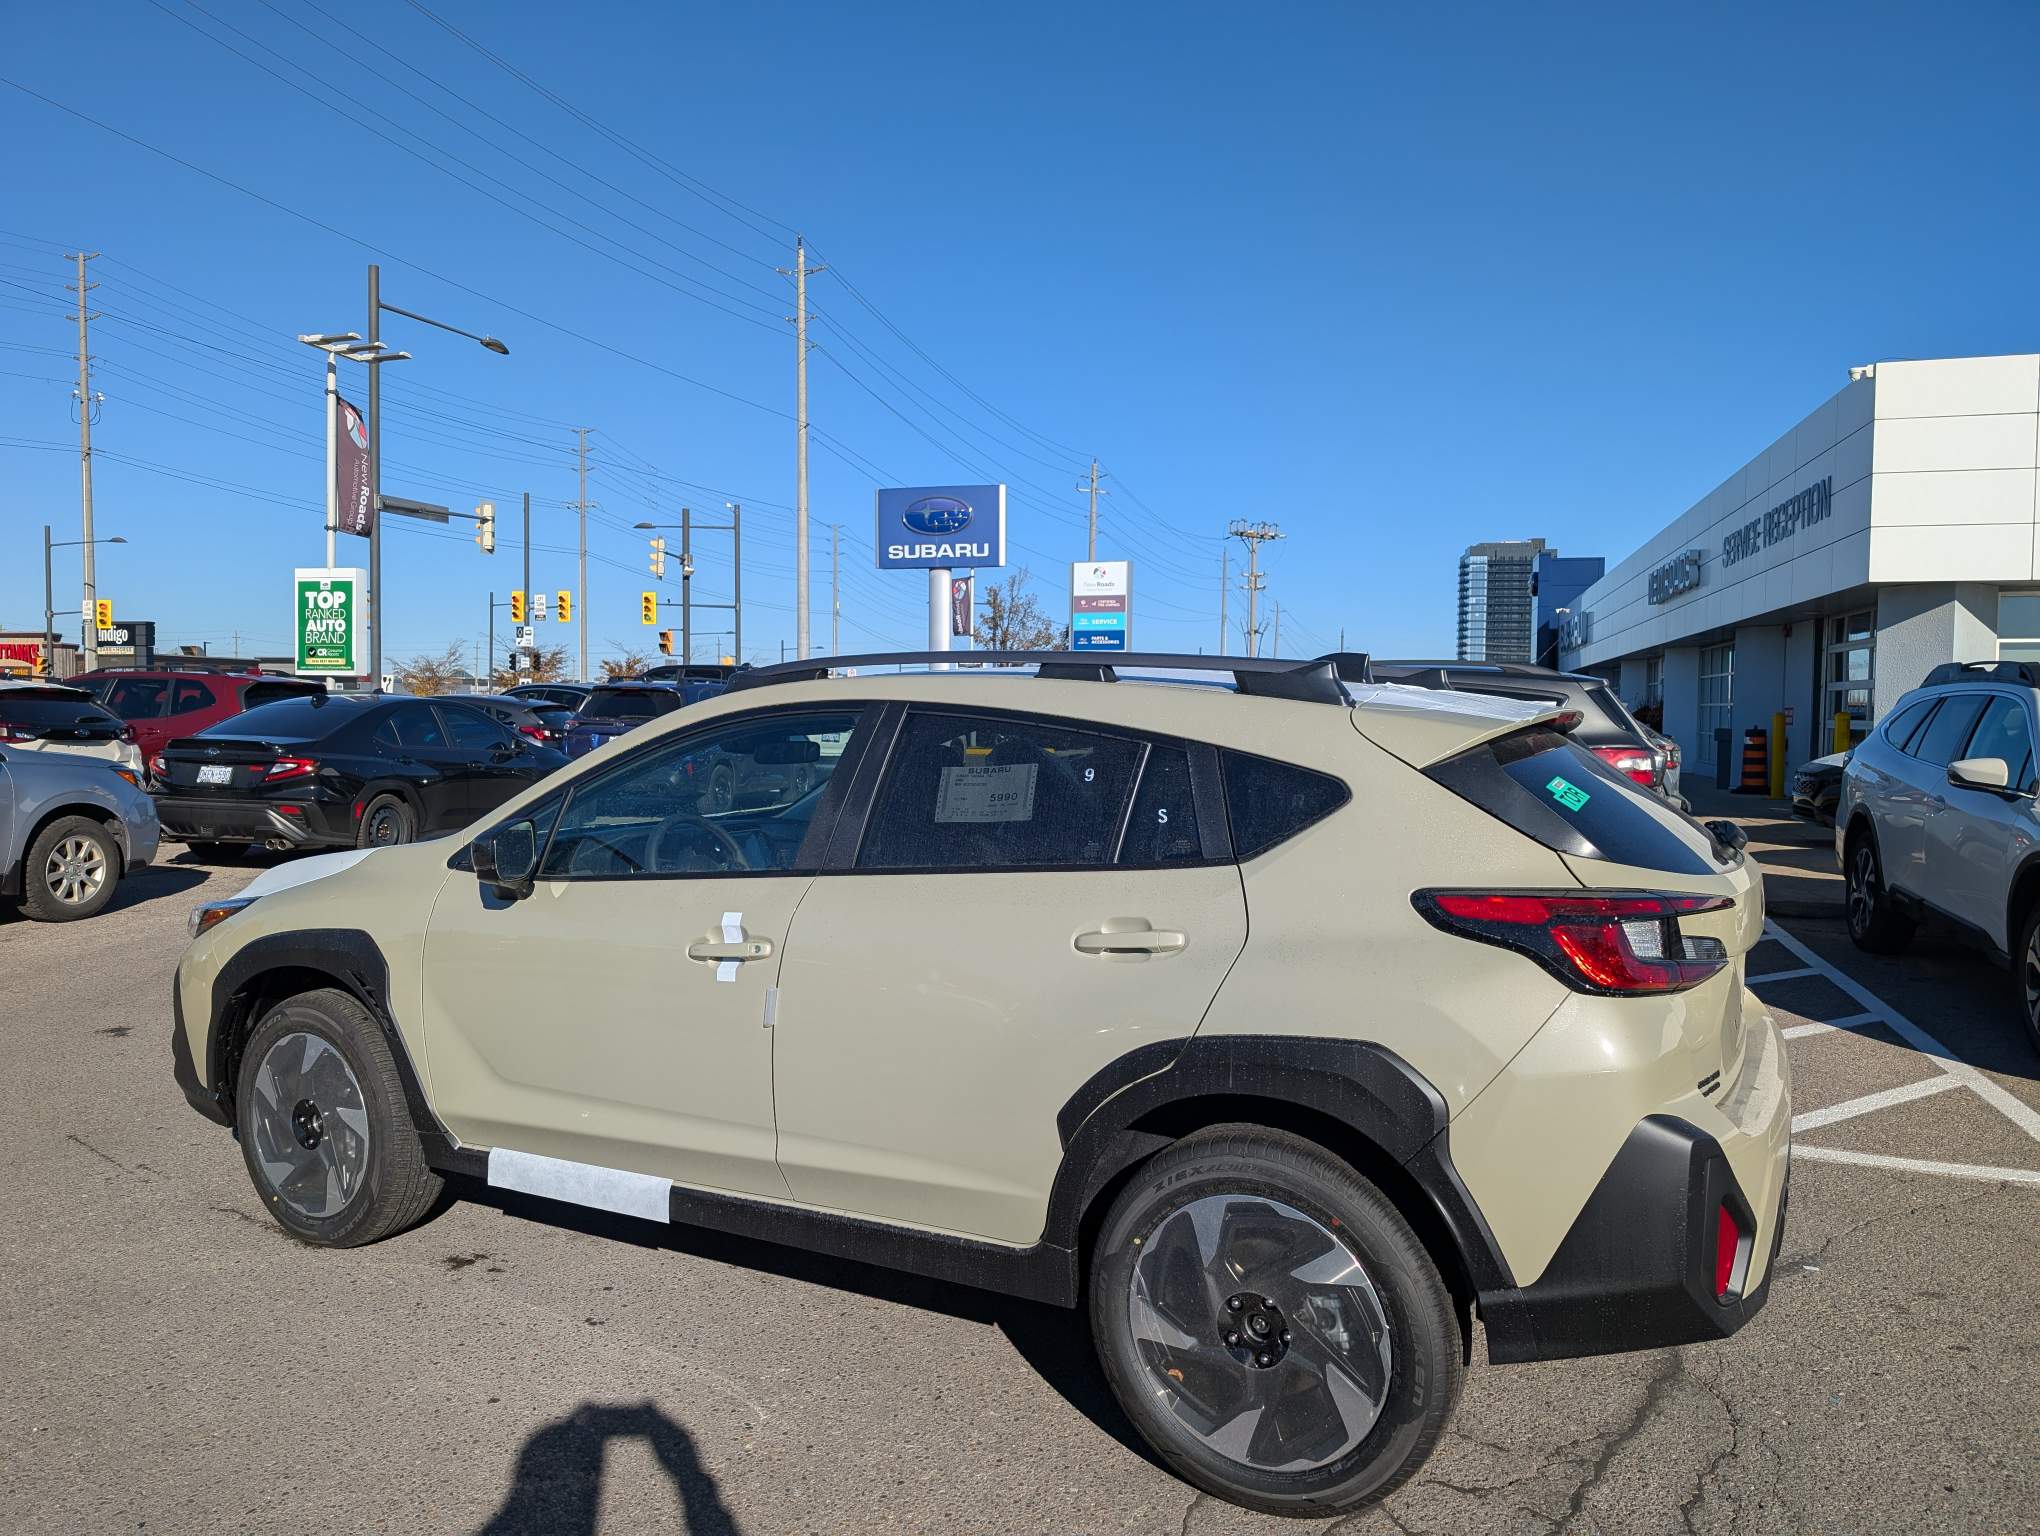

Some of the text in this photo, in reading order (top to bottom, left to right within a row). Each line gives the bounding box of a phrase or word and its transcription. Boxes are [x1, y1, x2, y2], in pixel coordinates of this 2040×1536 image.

[355, 452, 370, 531] NewRoads
[1722, 475, 1832, 569] SERVICE RECEPTION
[888, 543, 989, 559] SUBARU
[305, 591, 347, 609] TOP
[305, 609, 347, 620] RANKED
[306, 620, 347, 632] AUTO
[305, 632, 346, 644] BRAND
[317, 648, 327, 657] CR
[968, 766, 1012, 774] SUBARU
[1084, 767, 1095, 781] 9
[1158, 808, 1168, 823] S
[1152, 1165, 1204, 1195] ZIEX
